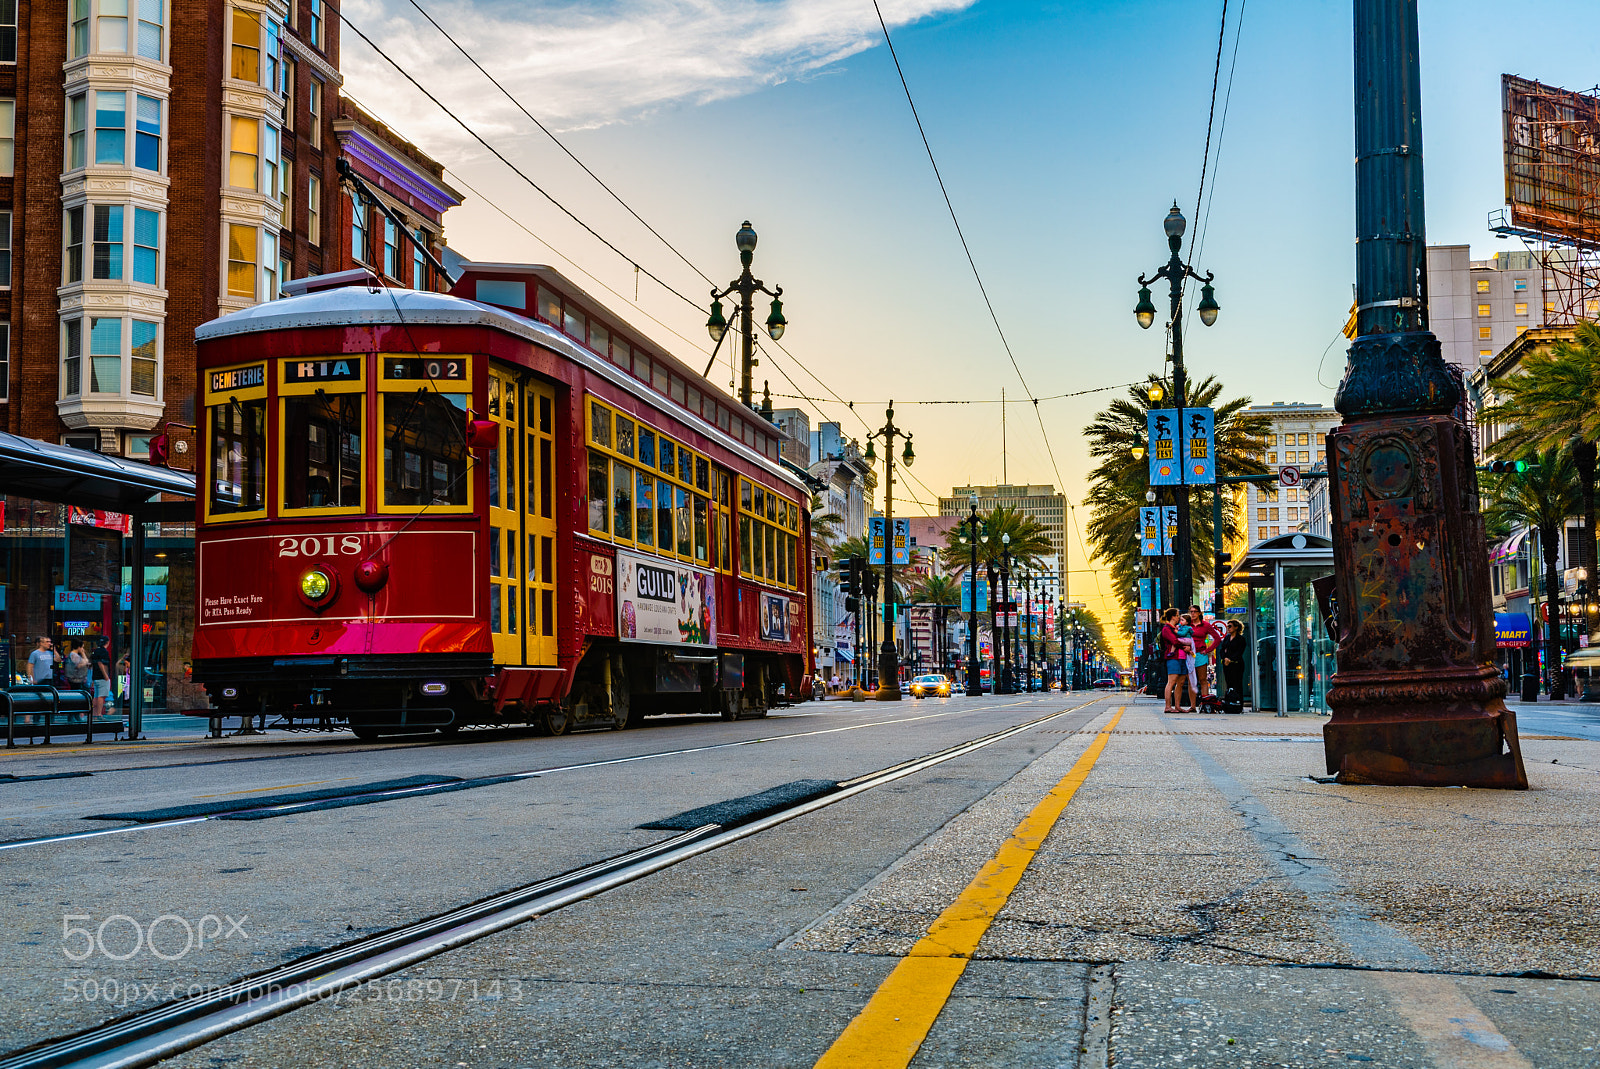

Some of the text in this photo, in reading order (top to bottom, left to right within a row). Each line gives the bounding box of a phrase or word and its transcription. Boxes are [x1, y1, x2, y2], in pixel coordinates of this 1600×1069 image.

[297, 360, 351, 378] RTA
[1156, 450, 1172, 458] FEST
[1191, 449, 1207, 458] FEST
[278, 535, 362, 558] 2018
[594, 559, 603, 571] RTA
[590, 574, 613, 595] 2018
[637, 567, 675, 599] GUILD
[59, 592, 96, 603] BEADS
[125, 592, 161, 603] BDS
[204, 594, 264, 606] Please Have Exact Fare
[204, 606, 253, 617] Or RTA Pass Ready
[67, 627, 86, 636] OPEN
[1501, 630, 1528, 639] MART
